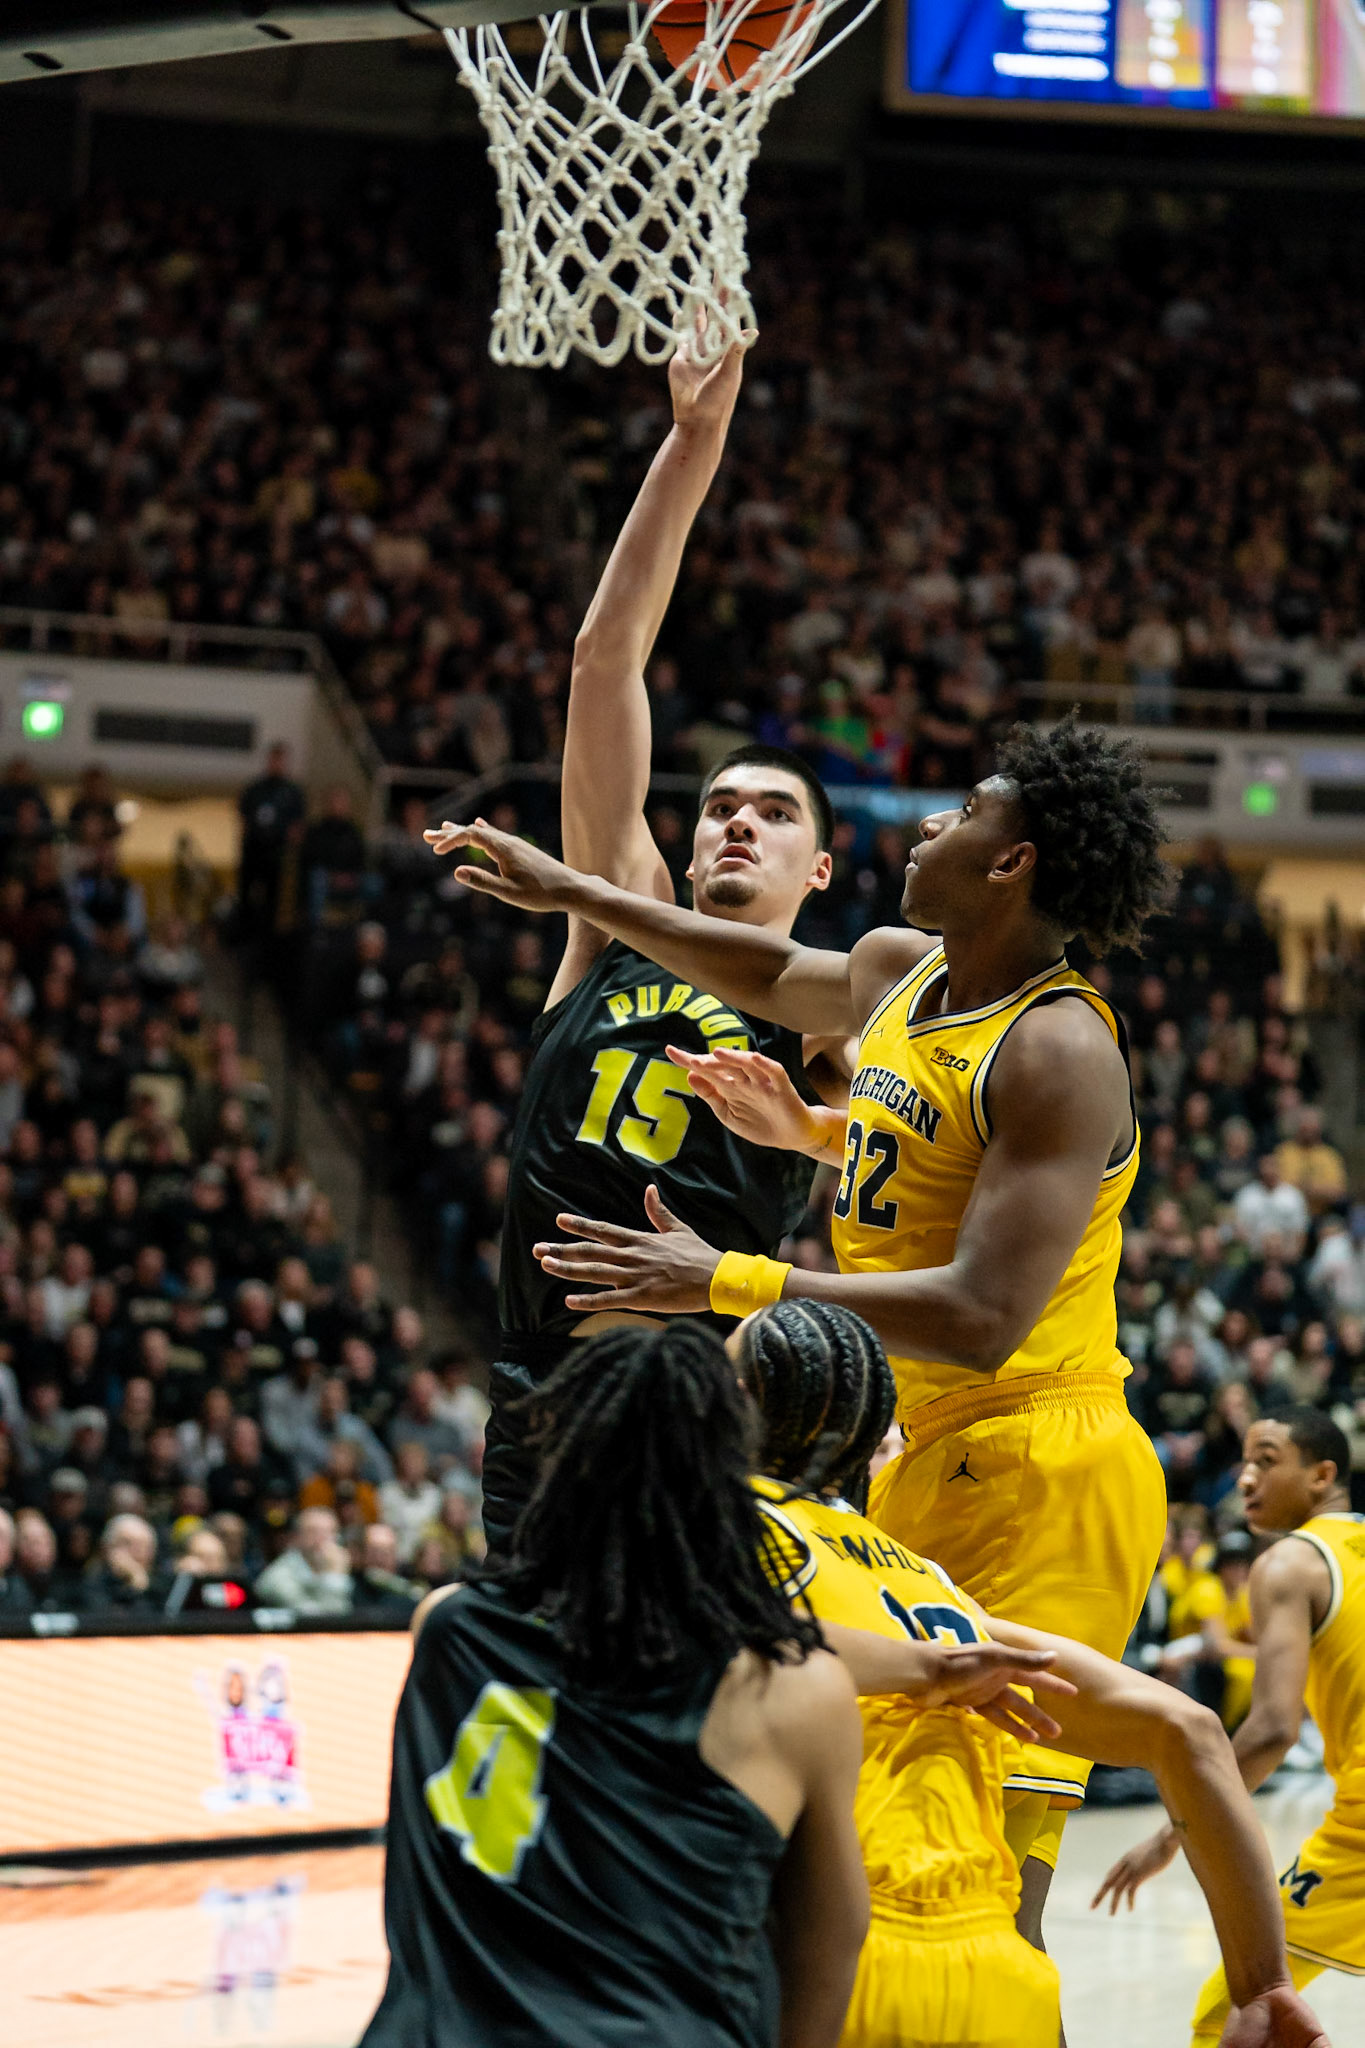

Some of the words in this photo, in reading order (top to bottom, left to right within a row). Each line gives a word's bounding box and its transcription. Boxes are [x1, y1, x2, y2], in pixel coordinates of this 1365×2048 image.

[575, 1047, 696, 1166] 15
[833, 1118, 900, 1231] 32
[424, 1680, 559, 1884] 4
[1279, 1854, 1325, 1909] M
